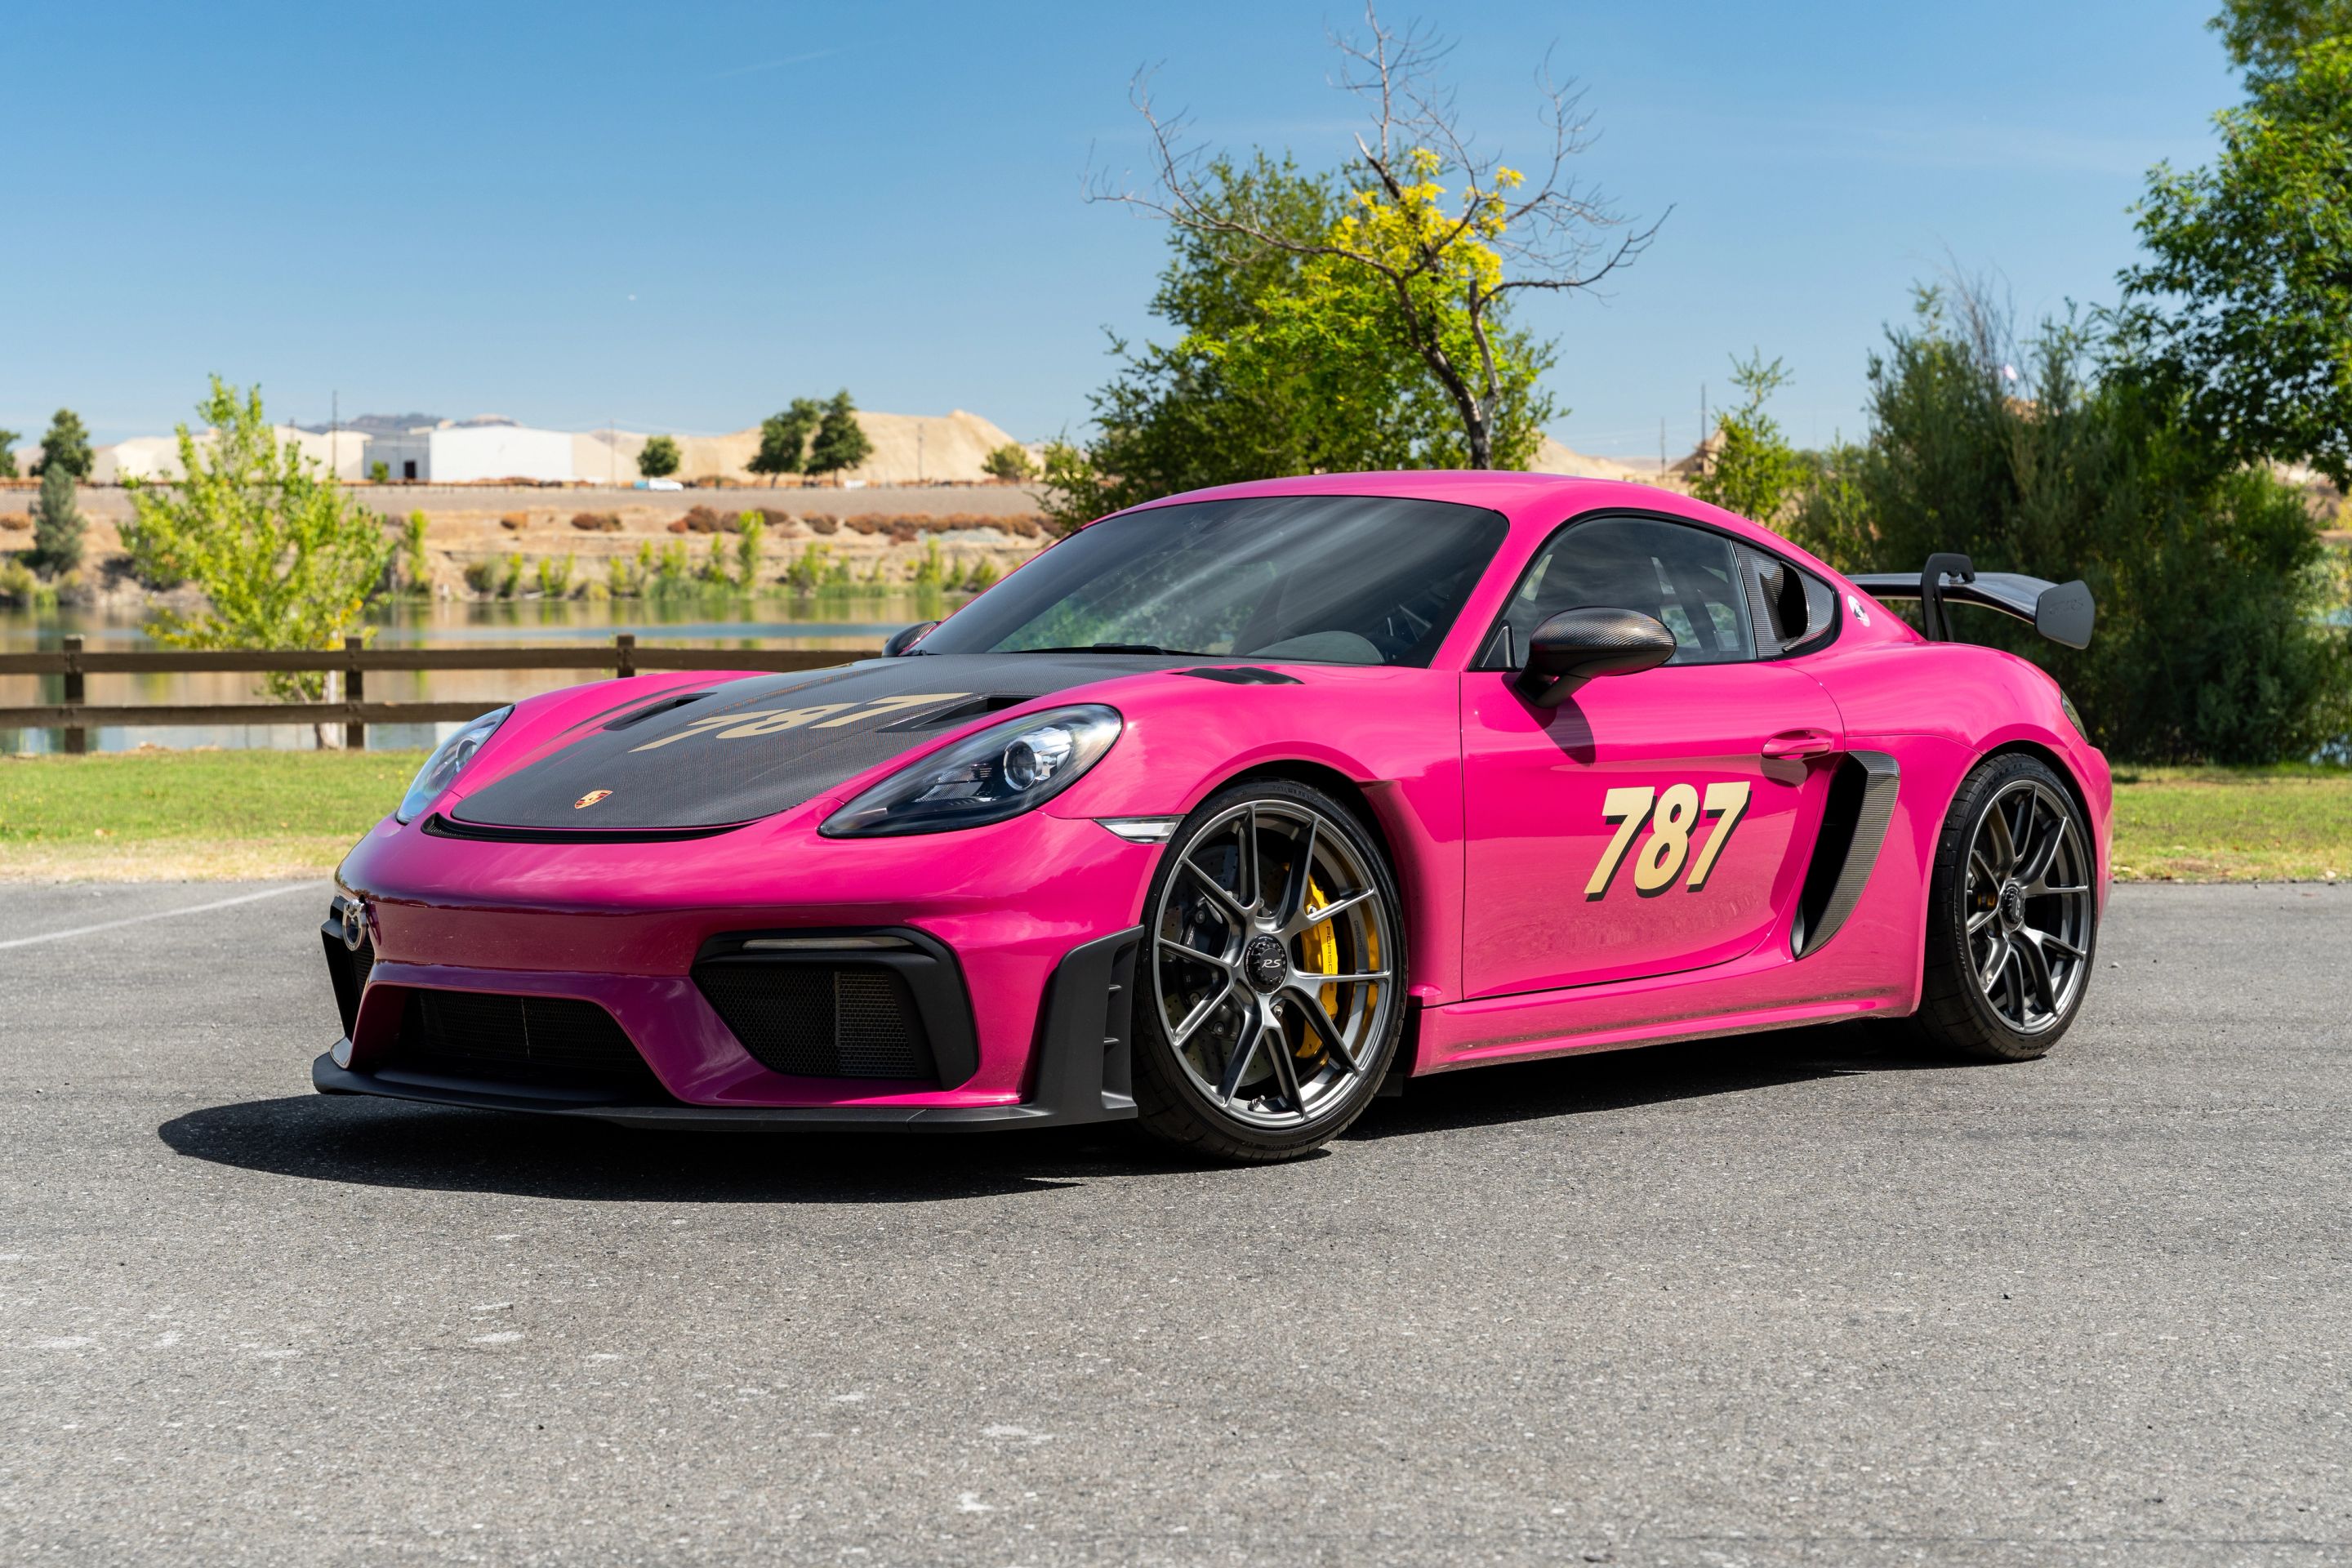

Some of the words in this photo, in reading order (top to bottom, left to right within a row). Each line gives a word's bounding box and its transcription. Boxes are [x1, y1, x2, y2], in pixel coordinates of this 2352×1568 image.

[627, 693, 973, 753] 787
[1584, 782, 1753, 902] 787
[1262, 960, 1281, 968] RS
[1325, 925, 1334, 991] PORSCE
